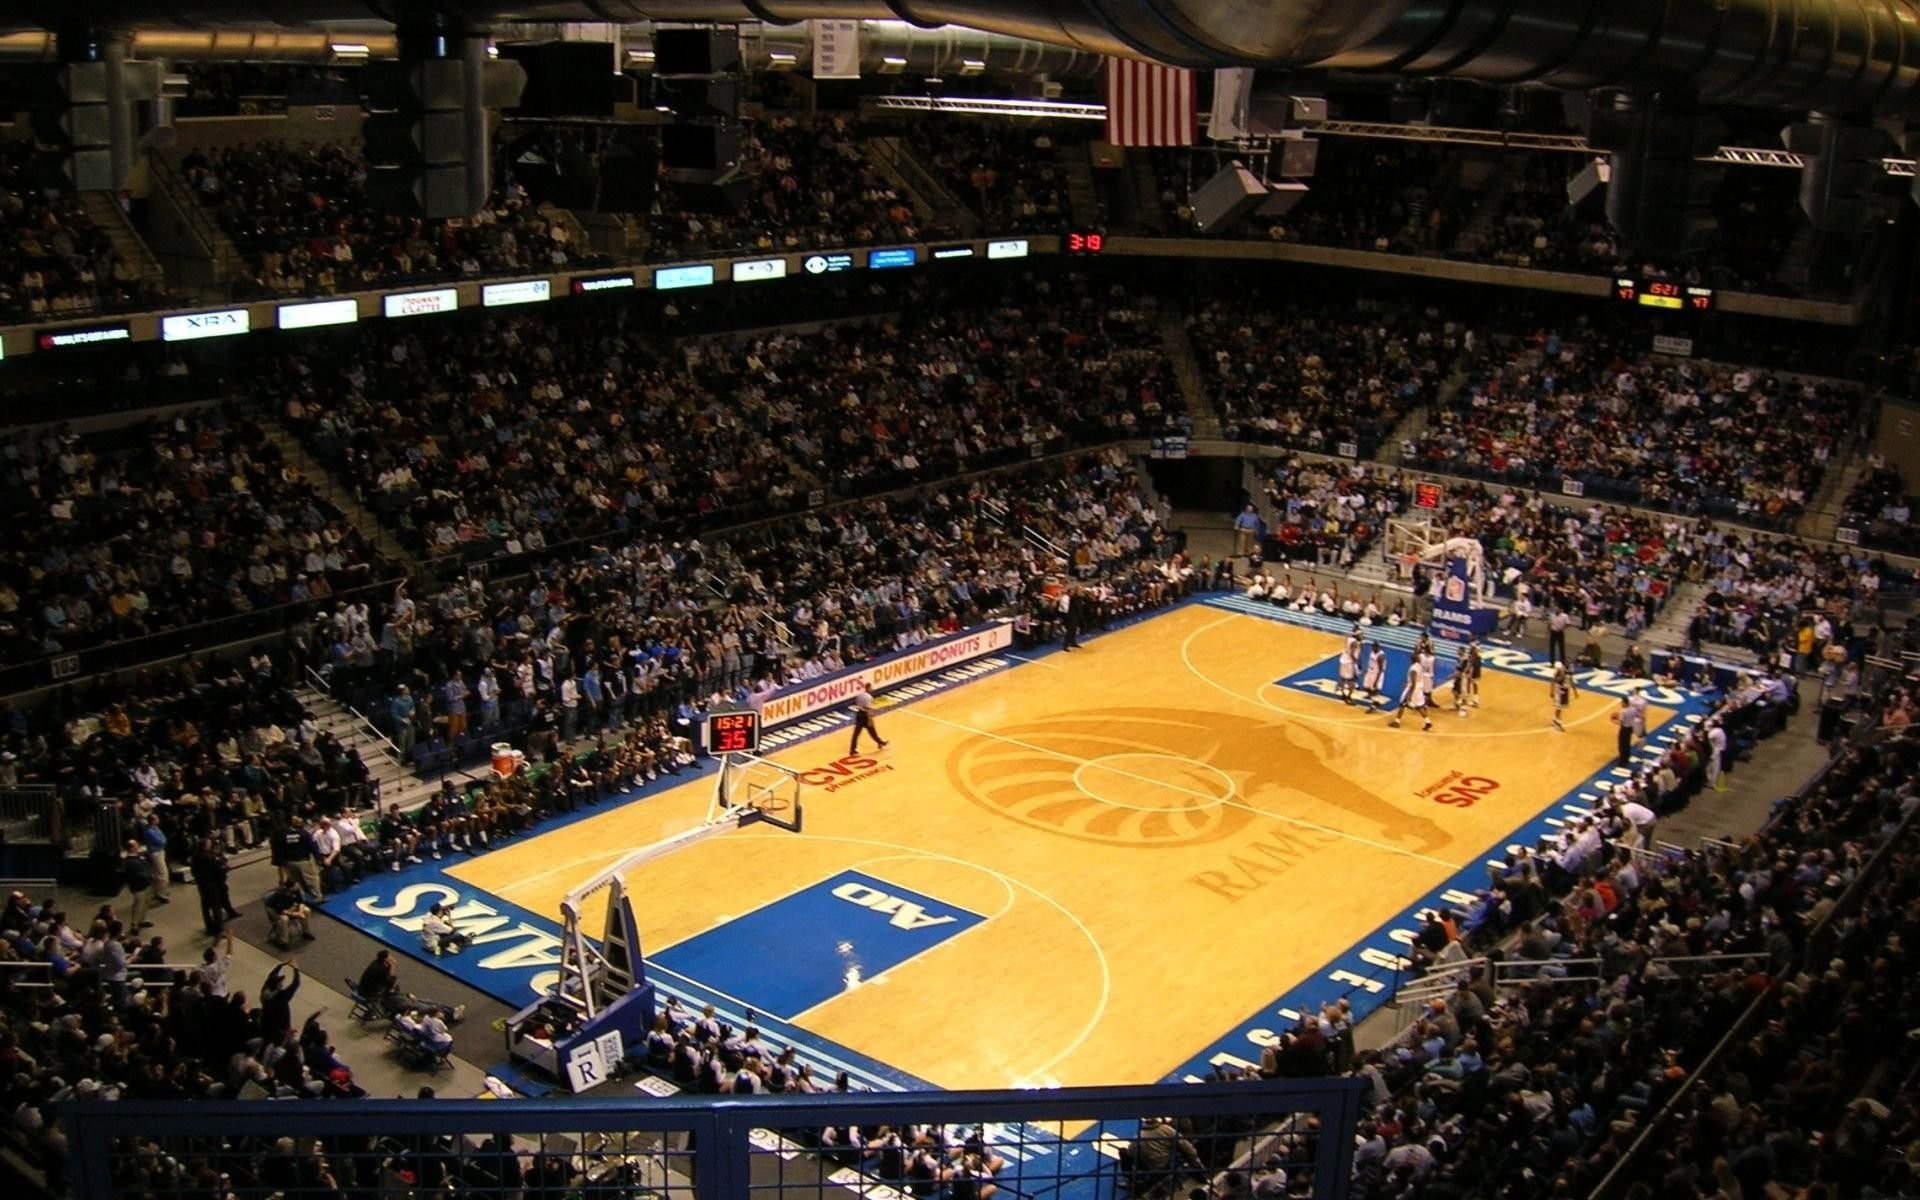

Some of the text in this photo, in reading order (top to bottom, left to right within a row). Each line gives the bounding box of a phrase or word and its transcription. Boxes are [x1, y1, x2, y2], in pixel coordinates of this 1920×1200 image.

[1069, 233, 1102, 251] 3:19
[1432, 608, 1472, 625] RAMS
[764, 637, 980, 721] NKIN' DONUTS DUNKIN' DONUTS
[717, 715, 753, 729] 15:21
[718, 730, 746, 749] 35
[799, 755, 878, 786] CVS
[1433, 776, 1500, 808] CVS
[1185, 816, 1344, 904] RAMS
[578, 1061, 598, 1084] R
